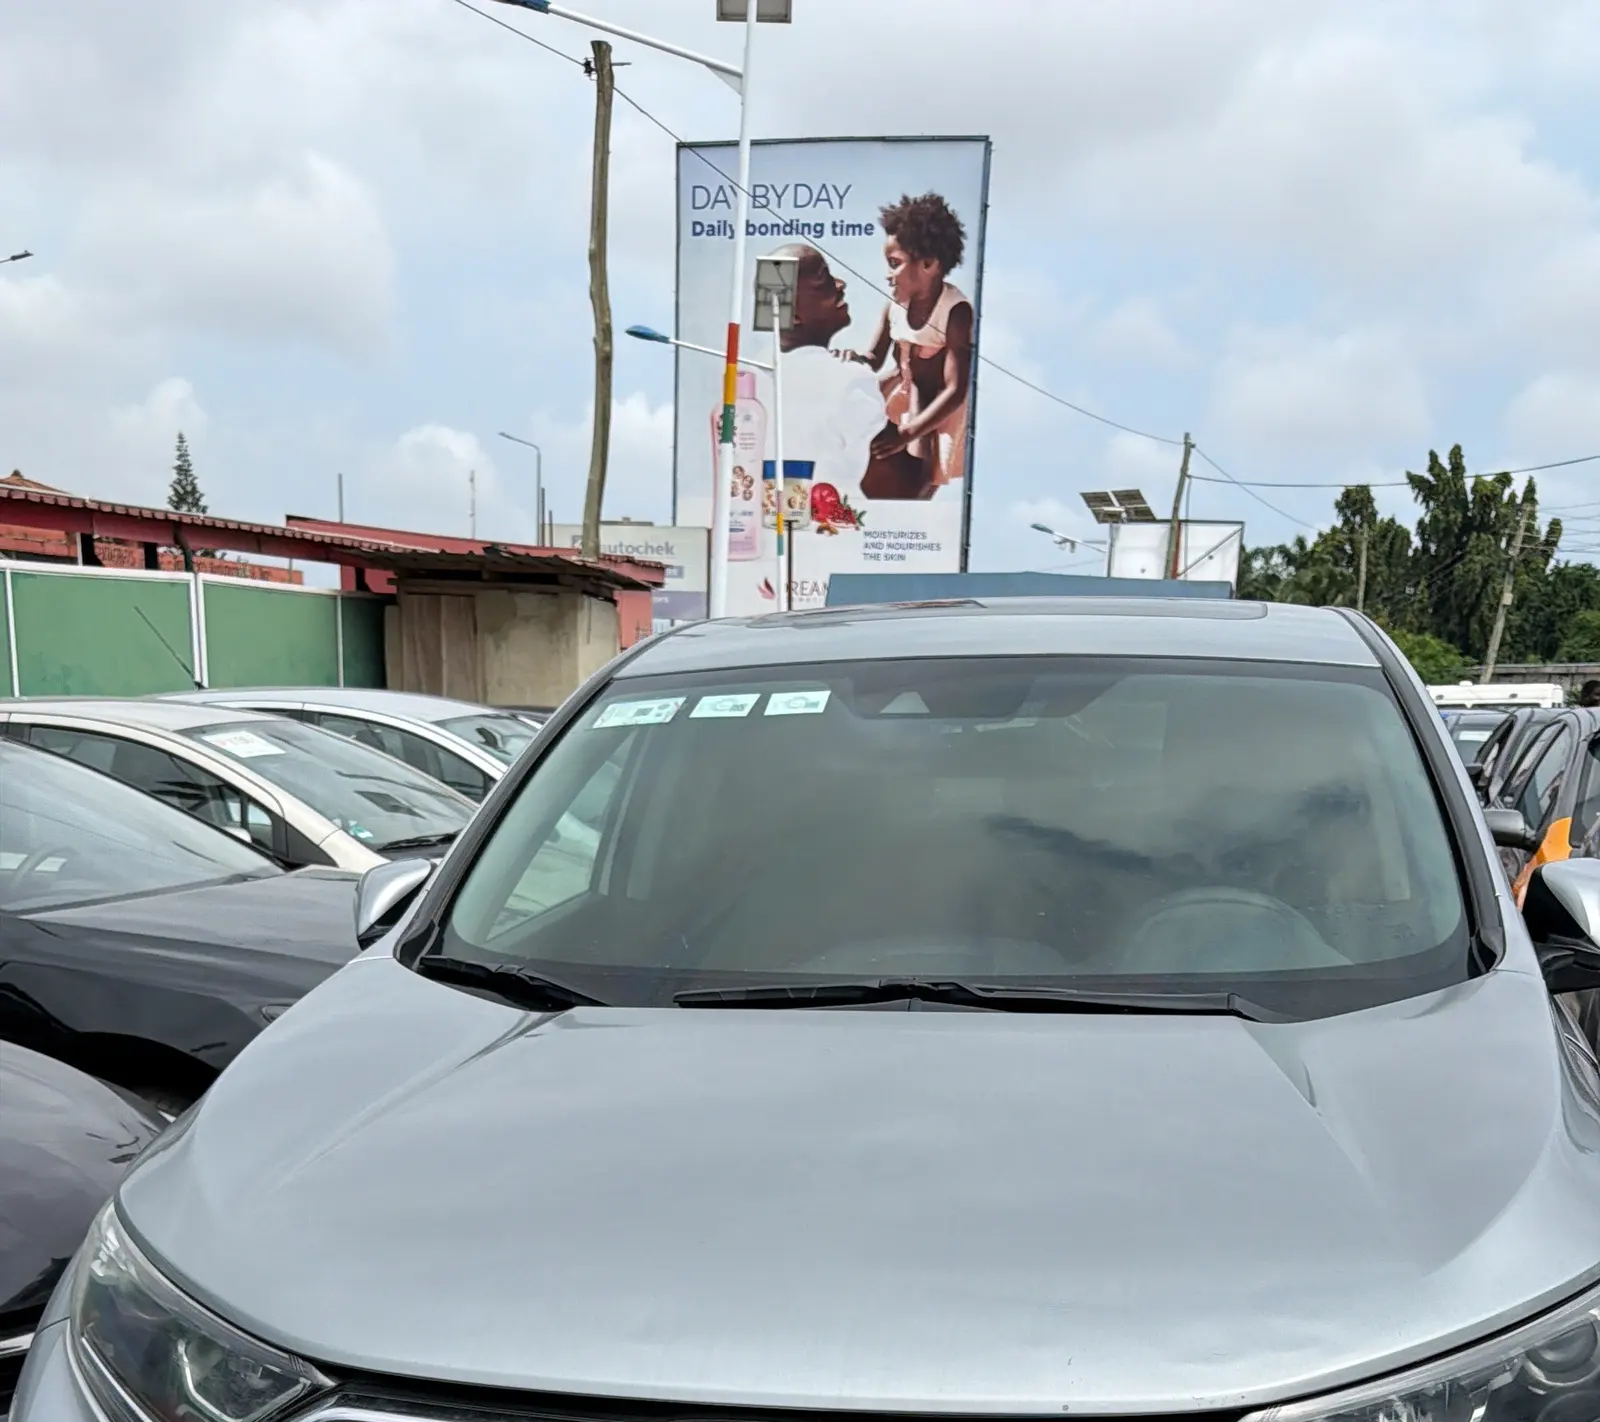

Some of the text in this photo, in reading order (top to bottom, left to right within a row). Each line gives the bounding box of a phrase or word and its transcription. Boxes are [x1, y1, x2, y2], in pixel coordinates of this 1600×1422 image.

[745, 219, 824, 239] bonding
[832, 220, 875, 236] time
[863, 530, 927, 540] MOISTURIZES
[863, 541, 942, 552] AND NOURISHES
[863, 552, 906, 561] THE SKIN
